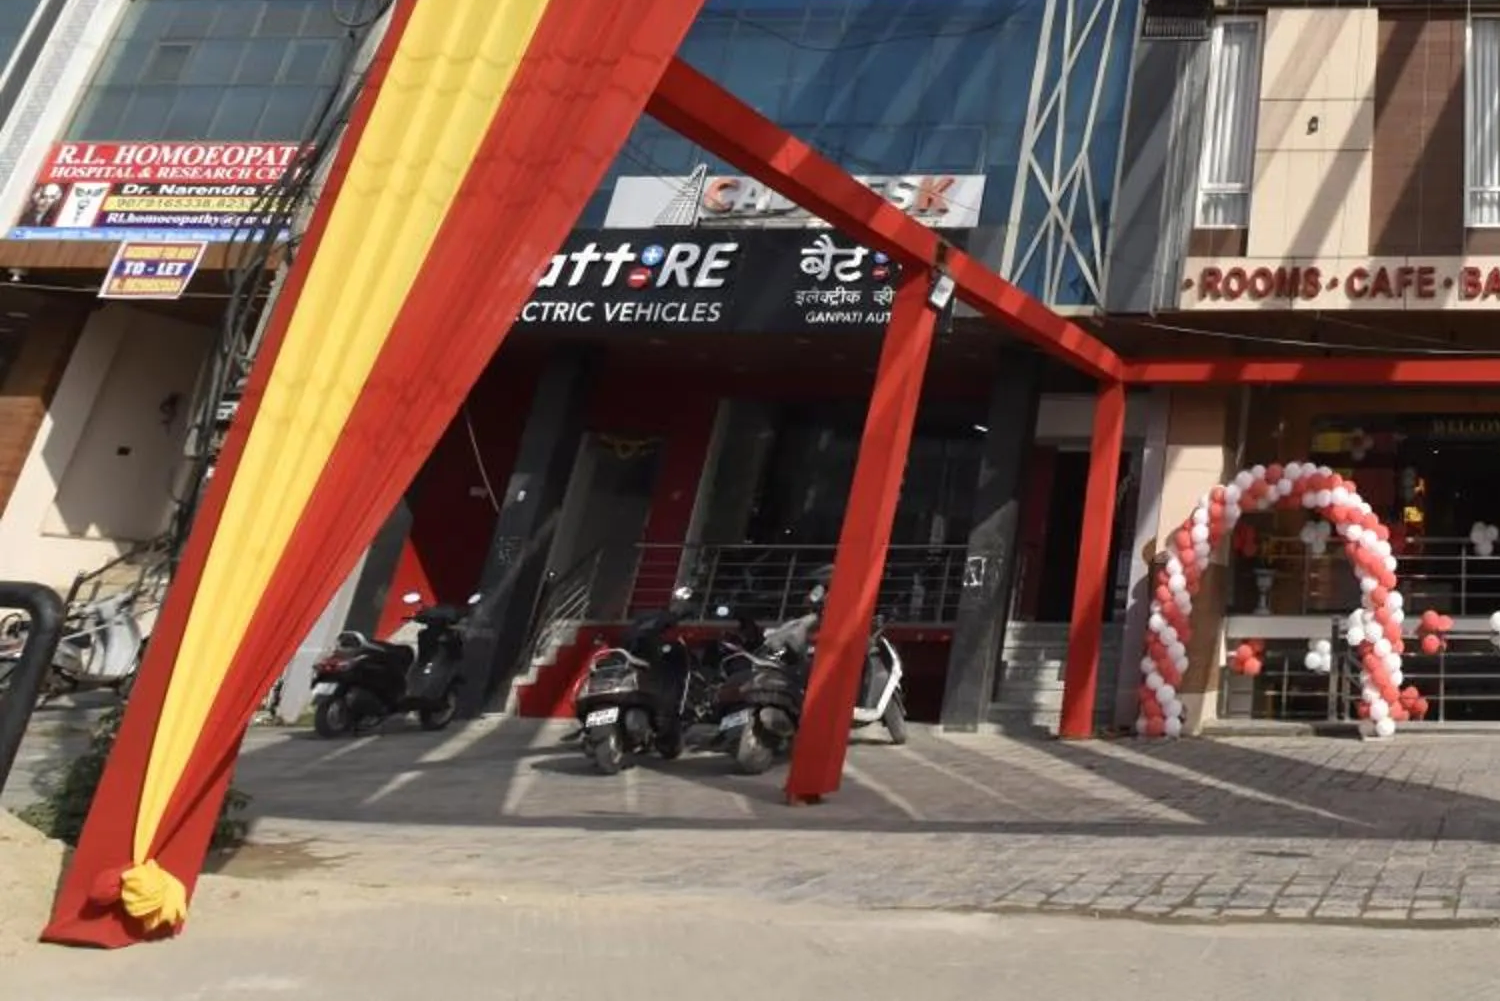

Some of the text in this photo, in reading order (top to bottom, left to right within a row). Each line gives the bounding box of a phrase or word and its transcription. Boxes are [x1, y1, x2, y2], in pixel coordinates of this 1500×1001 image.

[55, 146, 105, 165] R.L.
[50, 166, 132, 179] HOSPITAL
[138, 167, 152, 179] &
[156, 167, 250, 180] RESEARCH
[121, 185, 151, 196] Dr.
[159, 185, 256, 196] Narendra
[1199, 266, 1322, 301] ROOMS
[1345, 266, 1436, 300] CAFE
[604, 301, 722, 323] VEHICLES
[805, 310, 862, 324] GANPATI
